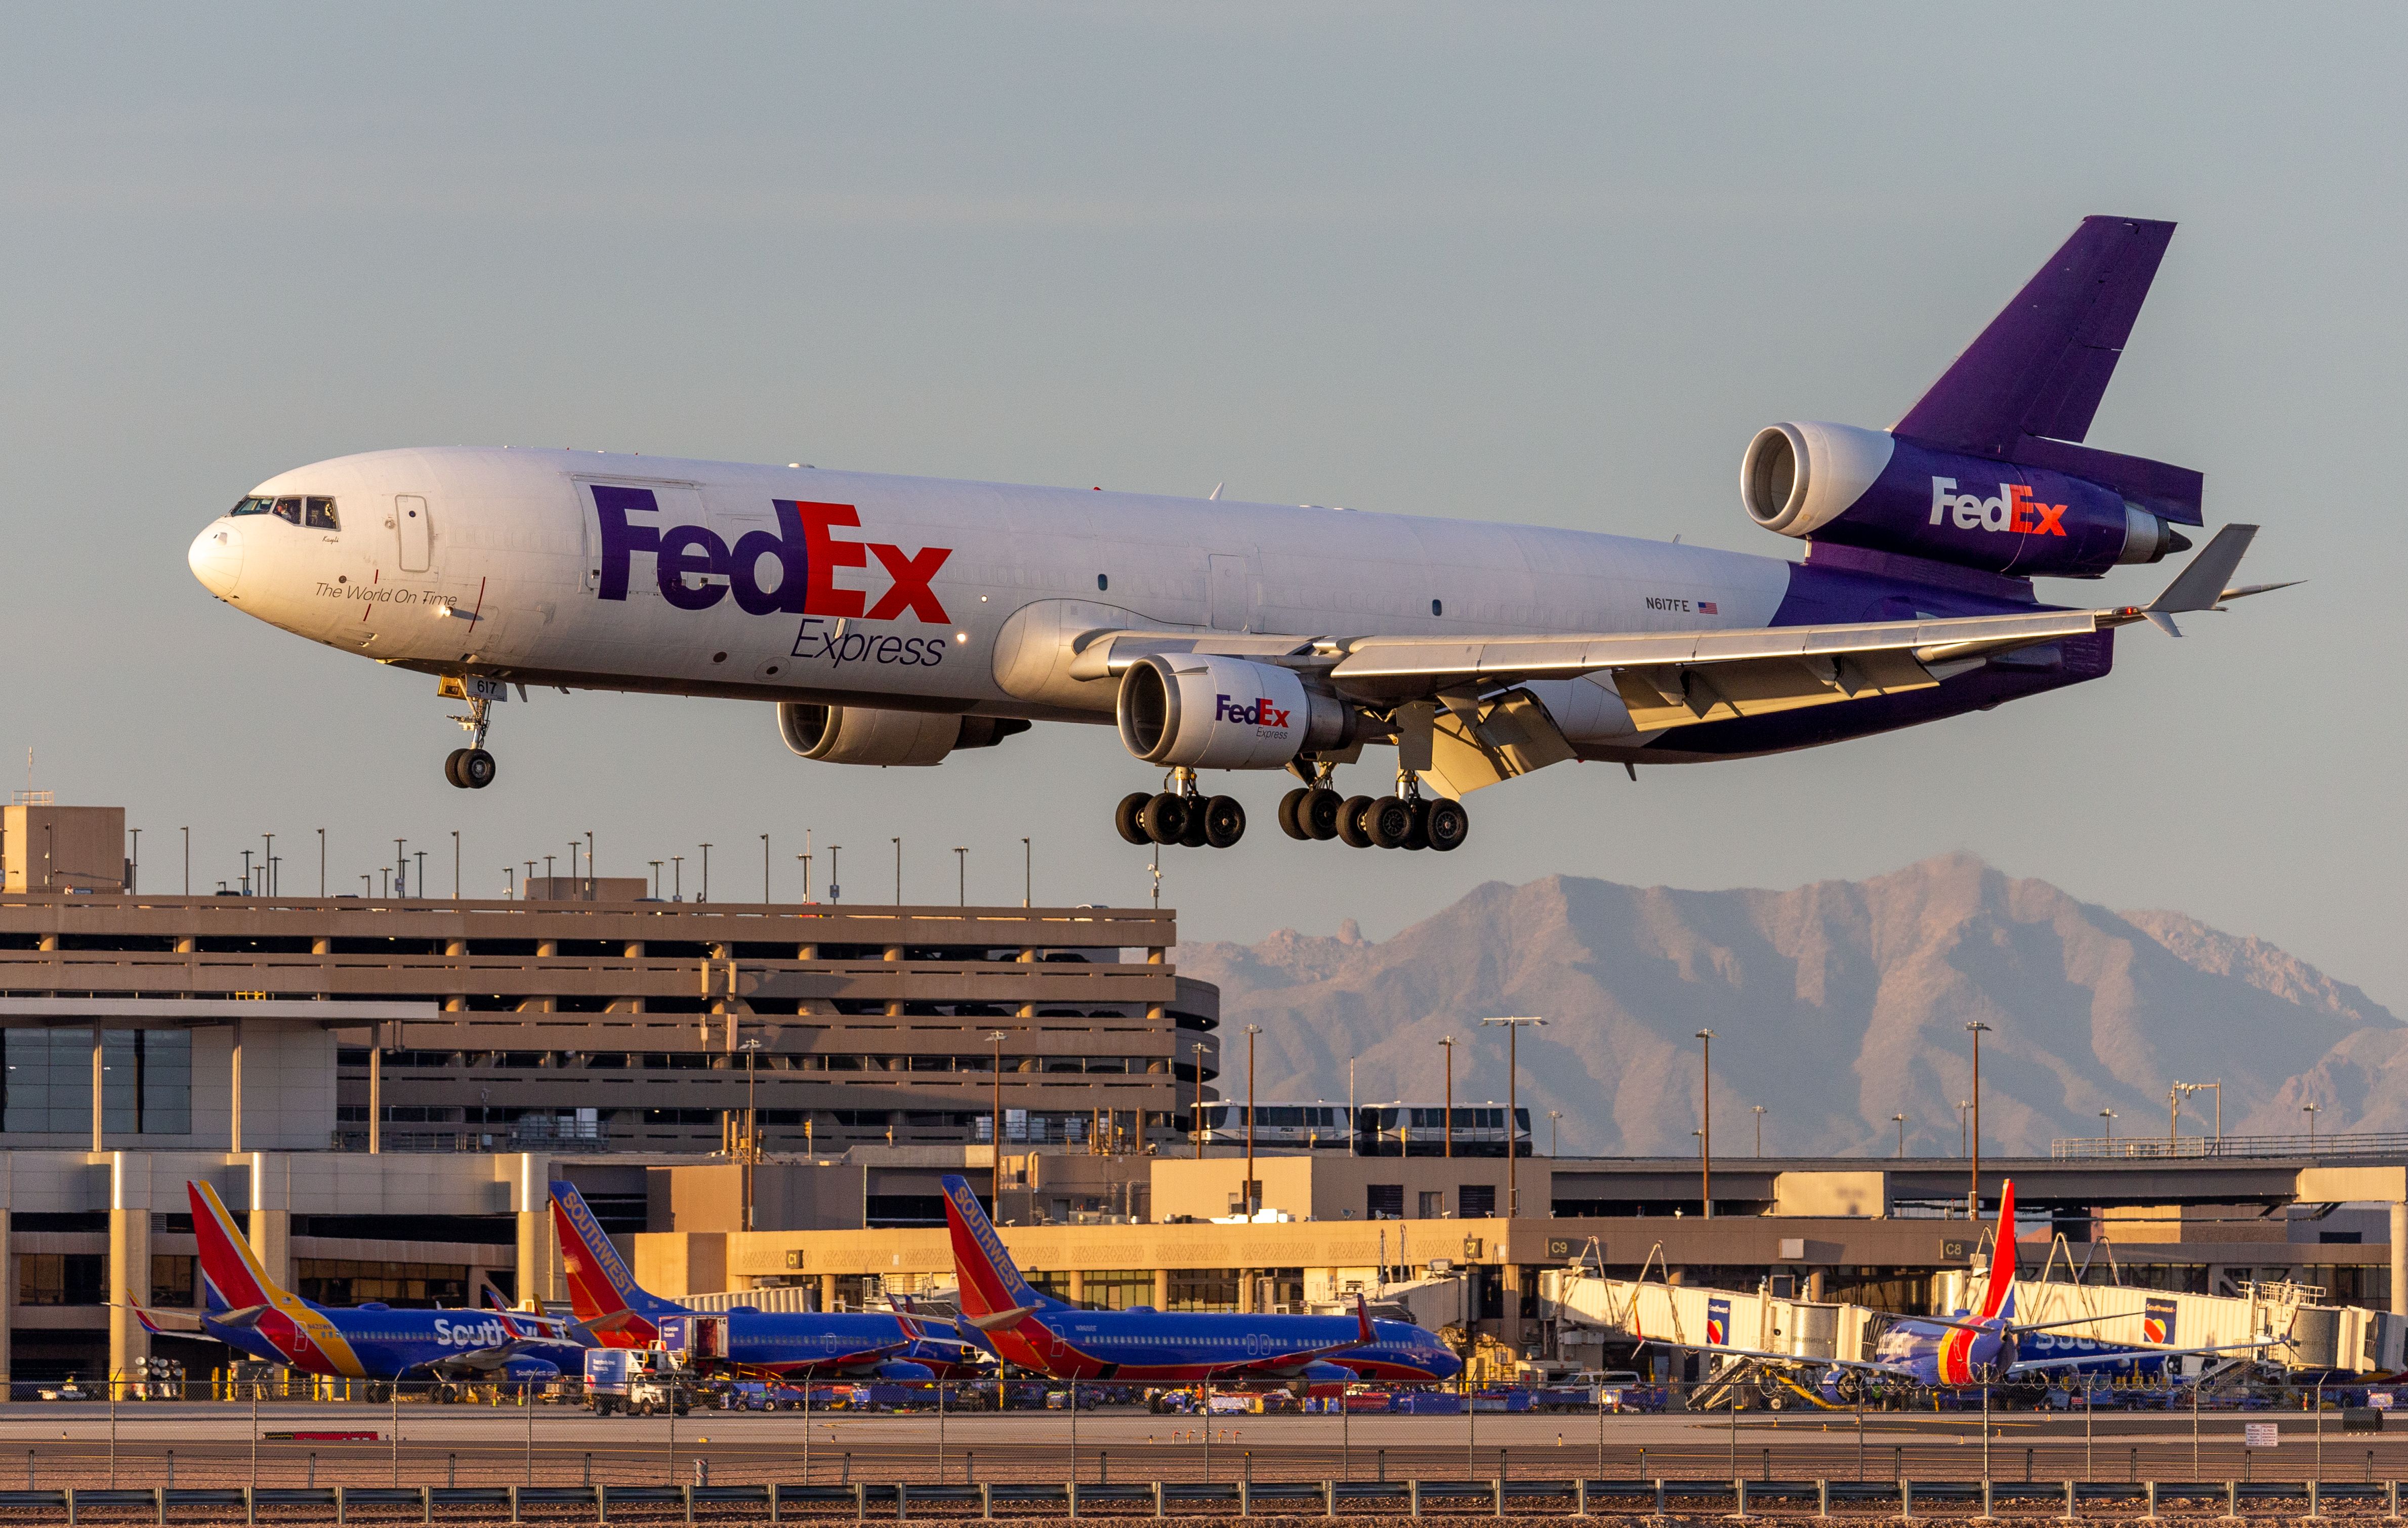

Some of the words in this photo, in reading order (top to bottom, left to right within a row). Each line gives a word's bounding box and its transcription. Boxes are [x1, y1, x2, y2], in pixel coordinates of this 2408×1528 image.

[1929, 476, 2068, 536] FedEx
[590, 485, 953, 624] FedEx
[316, 582, 343, 598] The
[347, 585, 393, 602] World
[395, 589, 417, 604] On
[423, 591, 458, 606] Time
[1646, 597, 1690, 612] N617FE
[791, 618, 946, 668] Express
[477, 680, 496, 694] 617
[1215, 694, 1291, 728] FedEx
[1256, 727, 1288, 740] Express
[563, 1191, 636, 1296] SOUTHWEST
[953, 1186, 1025, 1294] SOUTHWEST
[1552, 1242, 1567, 1253] C9
[1946, 1243, 1961, 1255] C8
